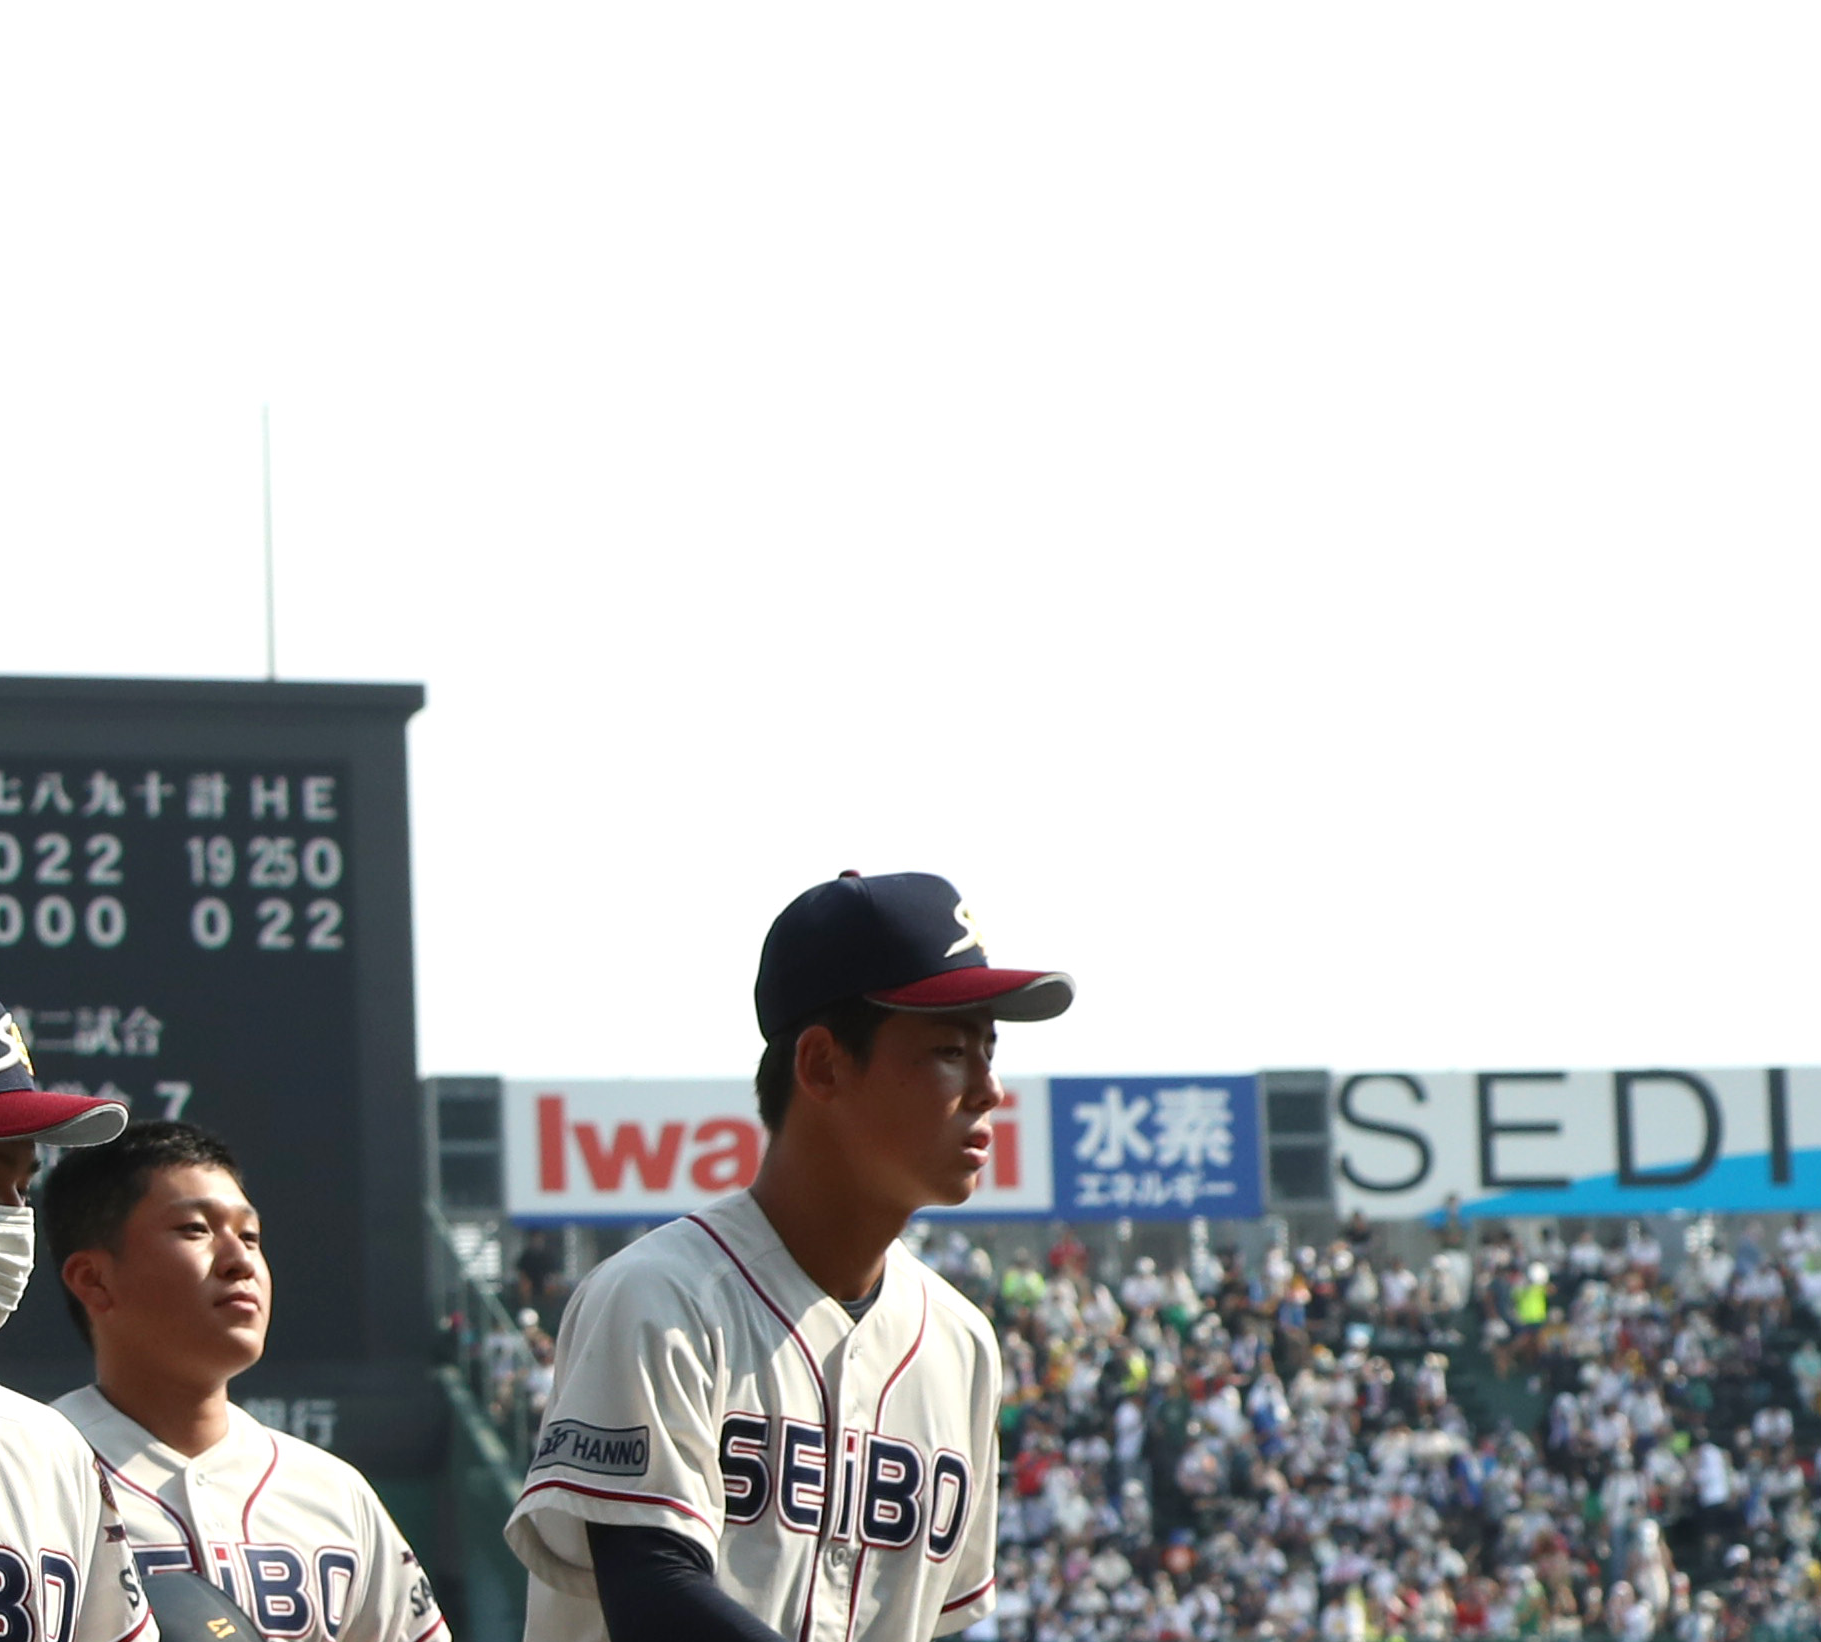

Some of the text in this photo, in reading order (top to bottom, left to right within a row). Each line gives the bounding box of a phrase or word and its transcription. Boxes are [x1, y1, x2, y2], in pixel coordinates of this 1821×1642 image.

[1073, 1086, 1234, 1168] 水素
[1075, 1174, 1236, 1209] エネルギー
[571, 1434, 647, 1466] HANNO
